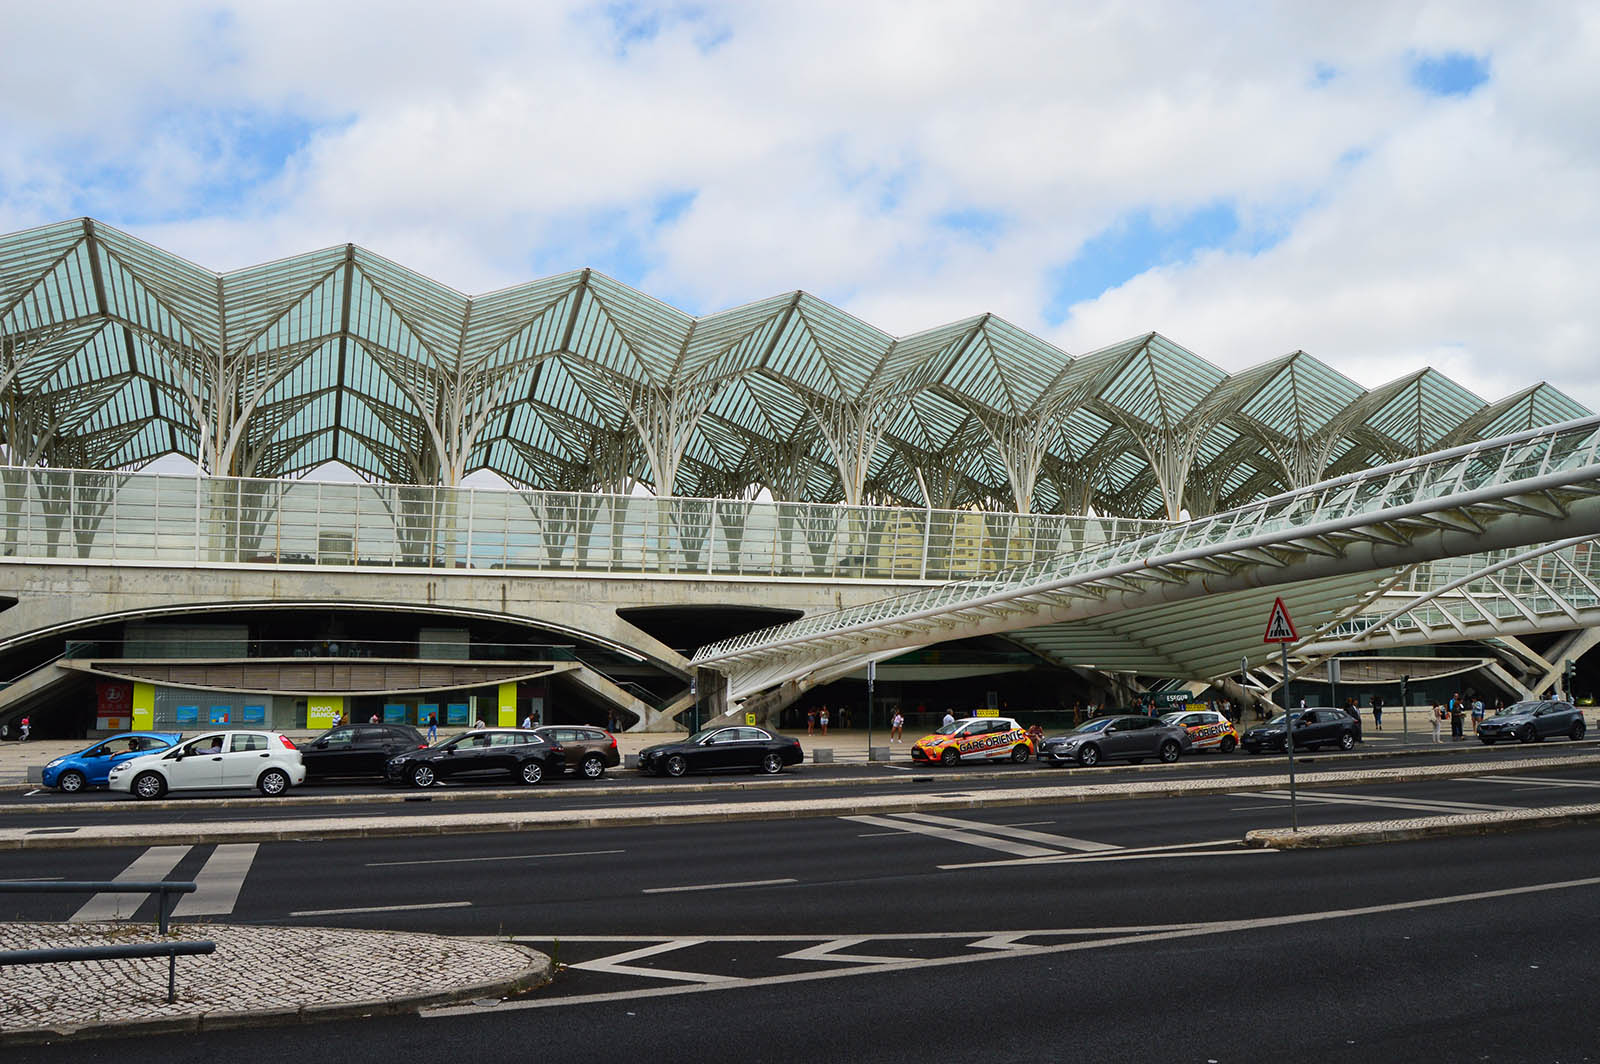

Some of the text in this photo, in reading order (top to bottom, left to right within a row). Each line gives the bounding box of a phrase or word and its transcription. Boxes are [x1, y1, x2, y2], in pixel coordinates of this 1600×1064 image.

[1198, 722, 1230, 738] ORIENTE
[960, 740, 985, 752] GARE
[985, 730, 1024, 747] ORIENTE
